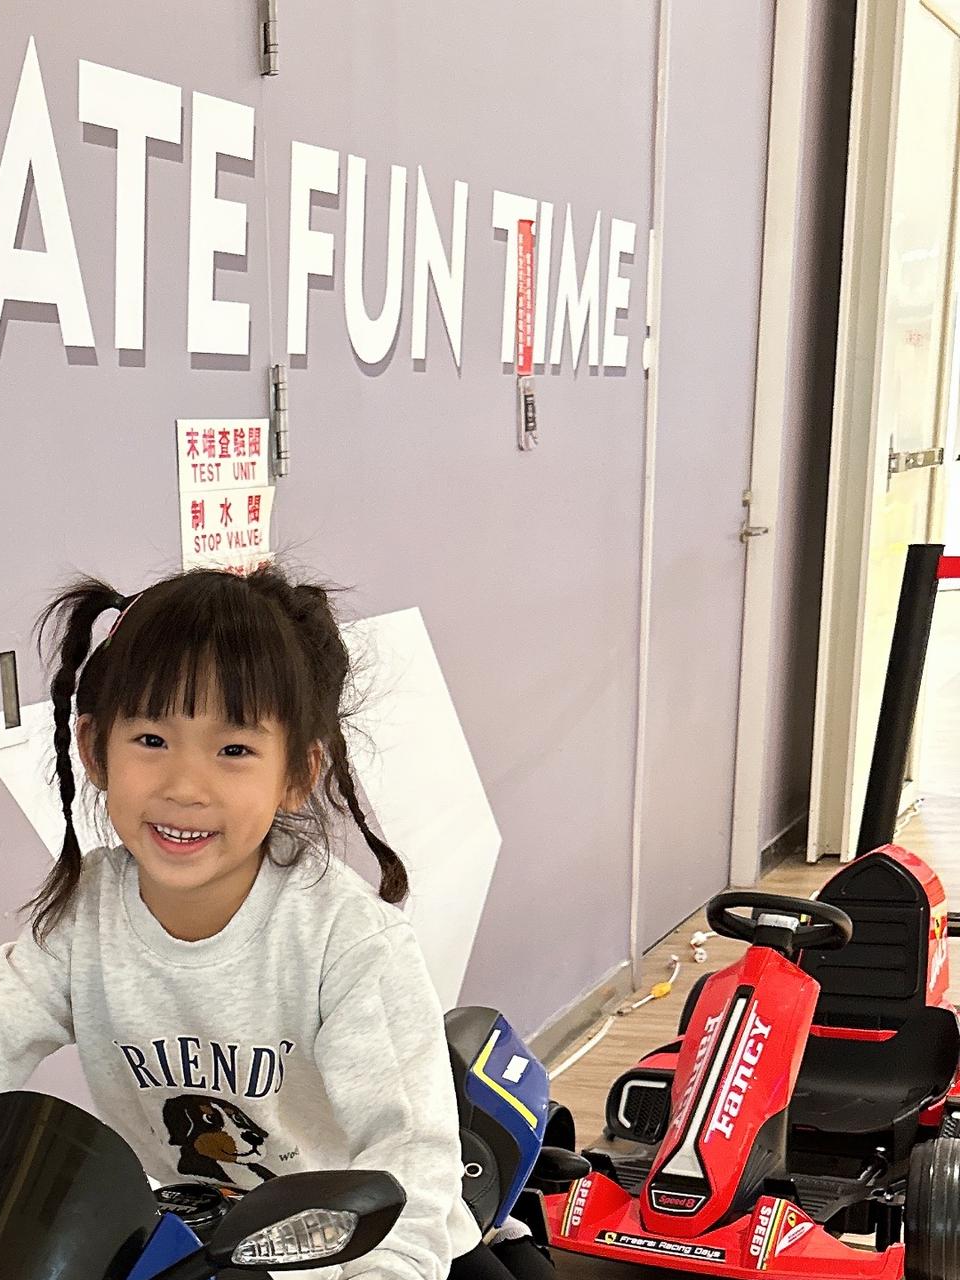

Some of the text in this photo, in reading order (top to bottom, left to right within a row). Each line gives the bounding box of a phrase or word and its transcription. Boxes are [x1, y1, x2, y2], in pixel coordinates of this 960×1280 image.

[287, 140, 468, 369] FUN
[185, 427, 262, 460] 末端查驗閥
[191, 461, 257, 484] TEST UNIT
[194, 528, 261, 554] STOP VALVE
[113, 1036, 294, 1098] RIENDS
[571, 1178, 592, 1227] SPEED
[658, 1241, 692, 1254] Racing
[693, 1247, 721, 1259] Days
[749, 1205, 772, 1257] SPEED
